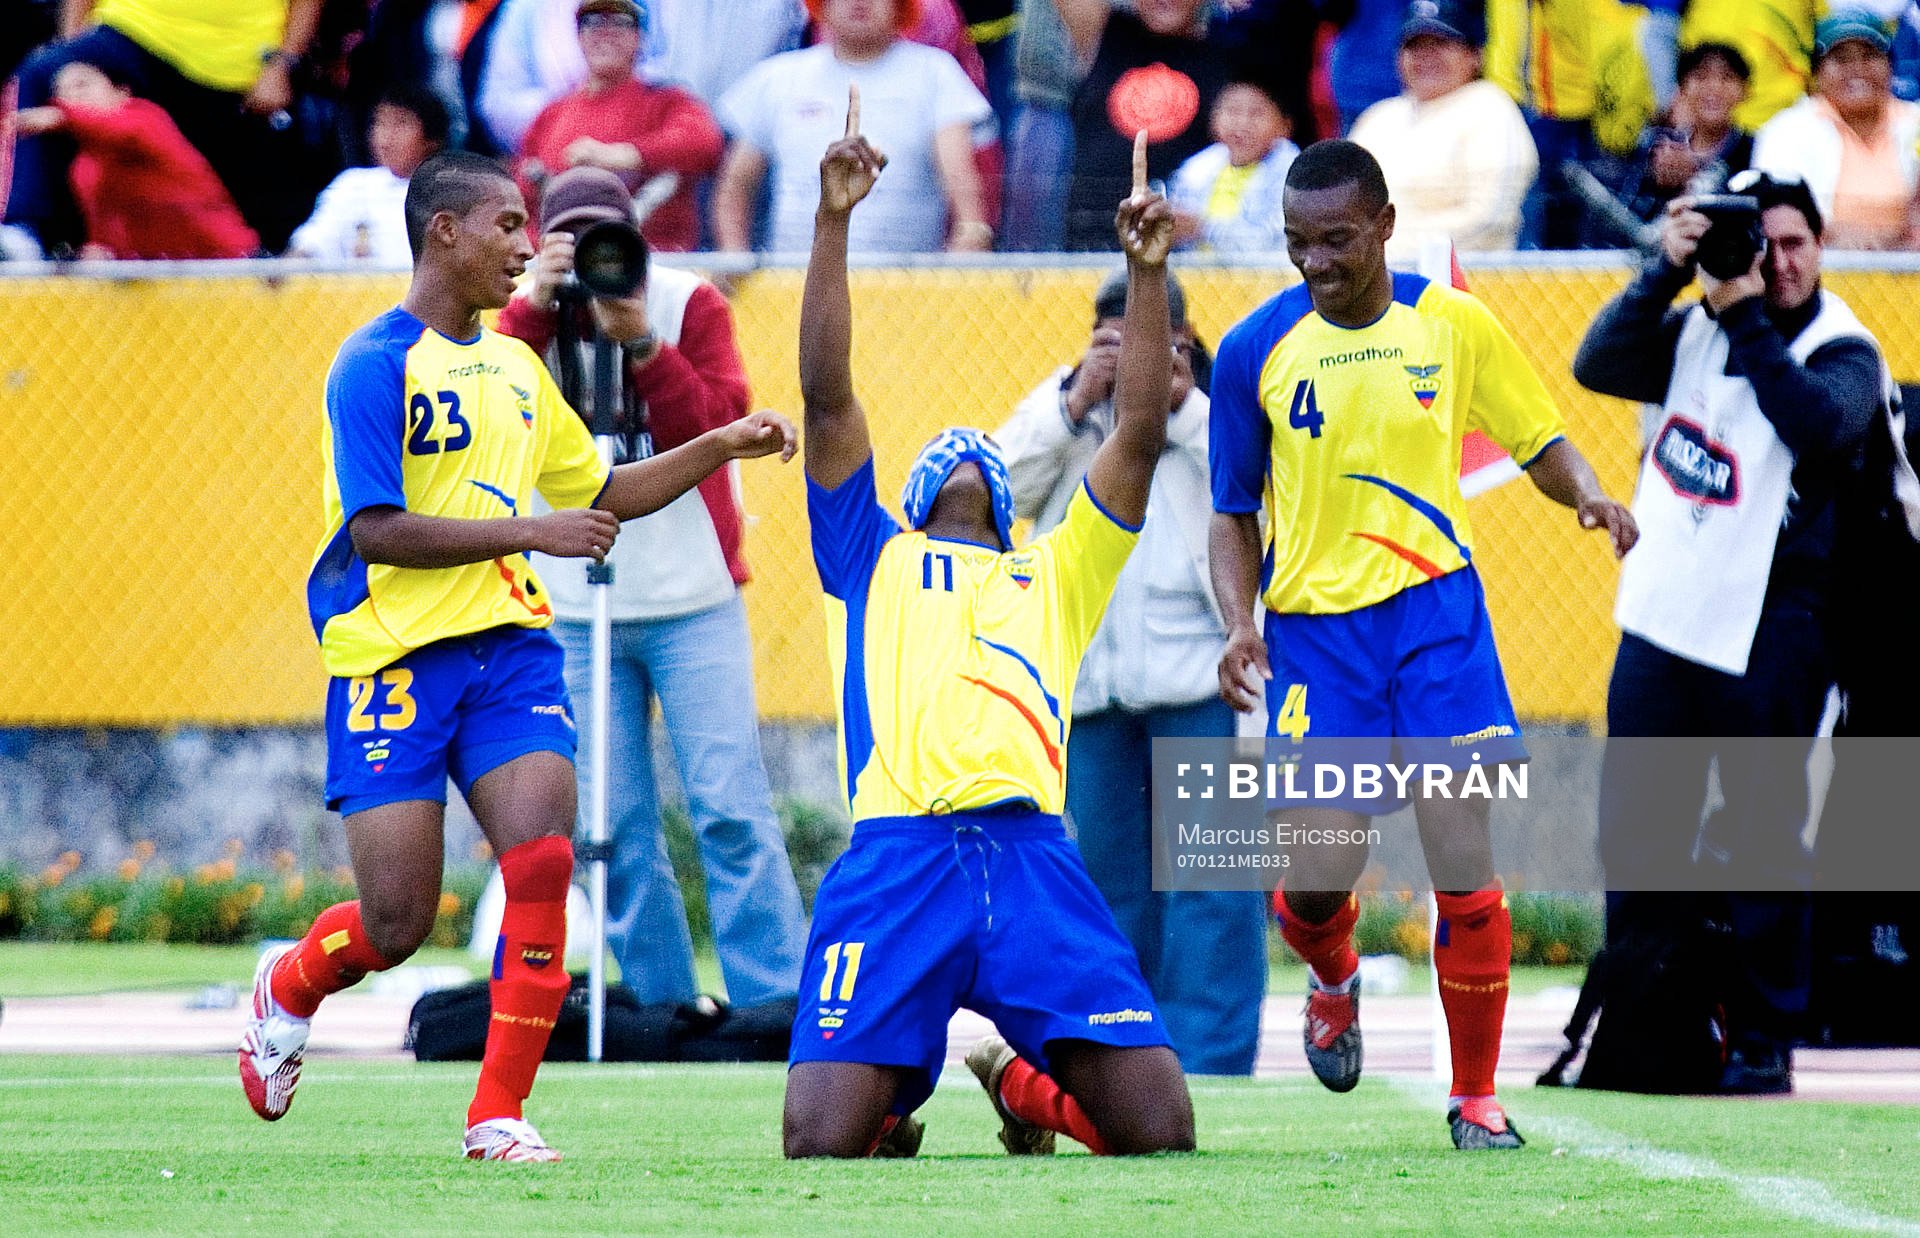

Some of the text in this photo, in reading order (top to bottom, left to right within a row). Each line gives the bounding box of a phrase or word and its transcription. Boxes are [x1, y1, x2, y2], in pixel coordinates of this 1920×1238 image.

[1319, 346, 1404, 368] marathon
[407, 390, 472, 456] 23
[1289, 378, 1325, 439] 4
[922, 551, 954, 592] 11
[347, 667, 417, 732] 23
[1277, 683, 1311, 745] 4
[819, 941, 866, 1002] 11
[1088, 1007, 1153, 1026] marathon
